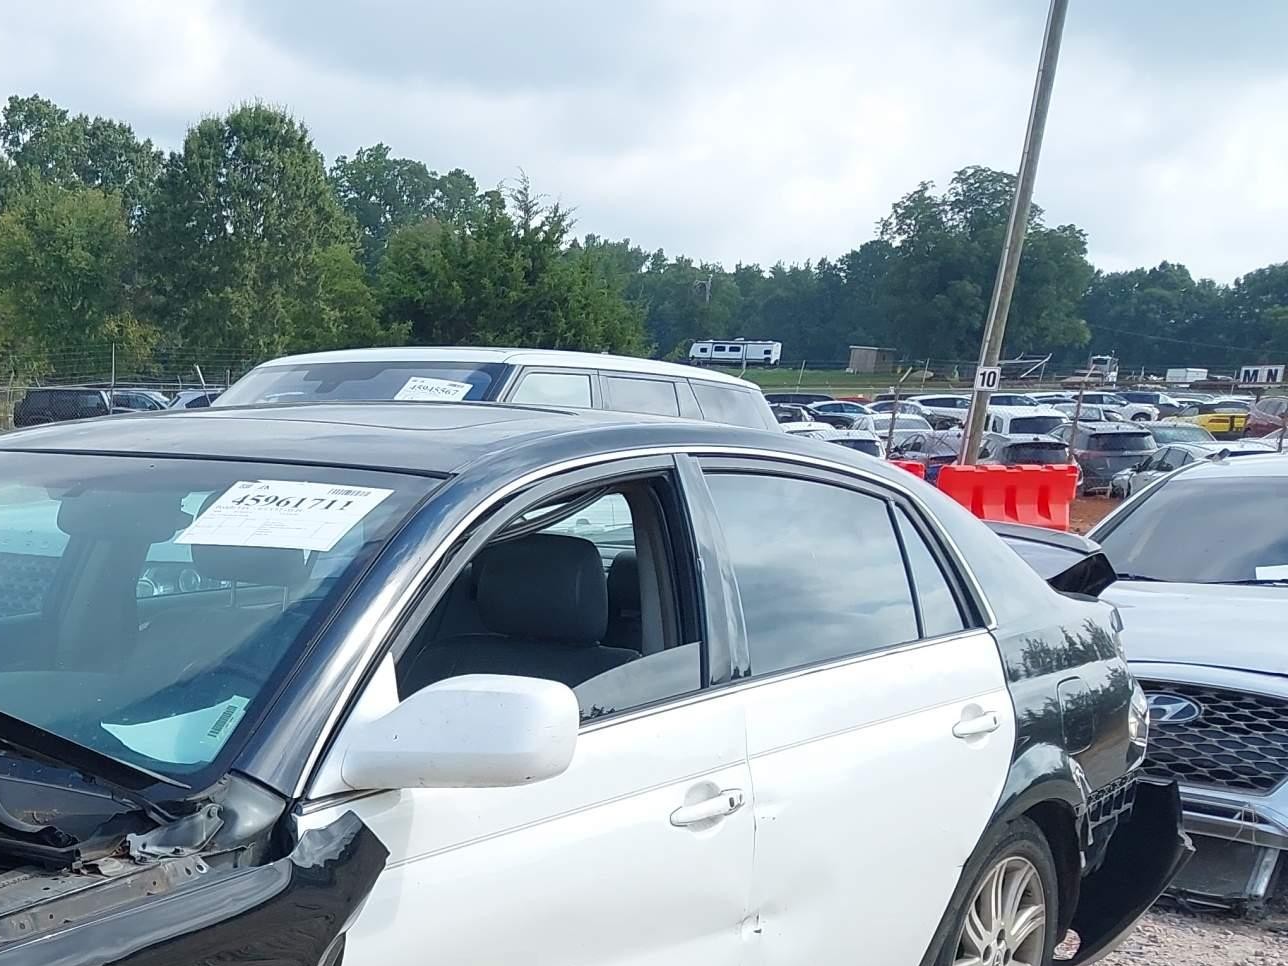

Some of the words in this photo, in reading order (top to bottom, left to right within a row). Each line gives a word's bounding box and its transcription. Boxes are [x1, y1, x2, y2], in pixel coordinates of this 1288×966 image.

[980, 370, 997, 387] 10
[1243, 369, 1260, 383] M
[1266, 368, 1279, 382] N
[231, 493, 354, 511] 45961711
